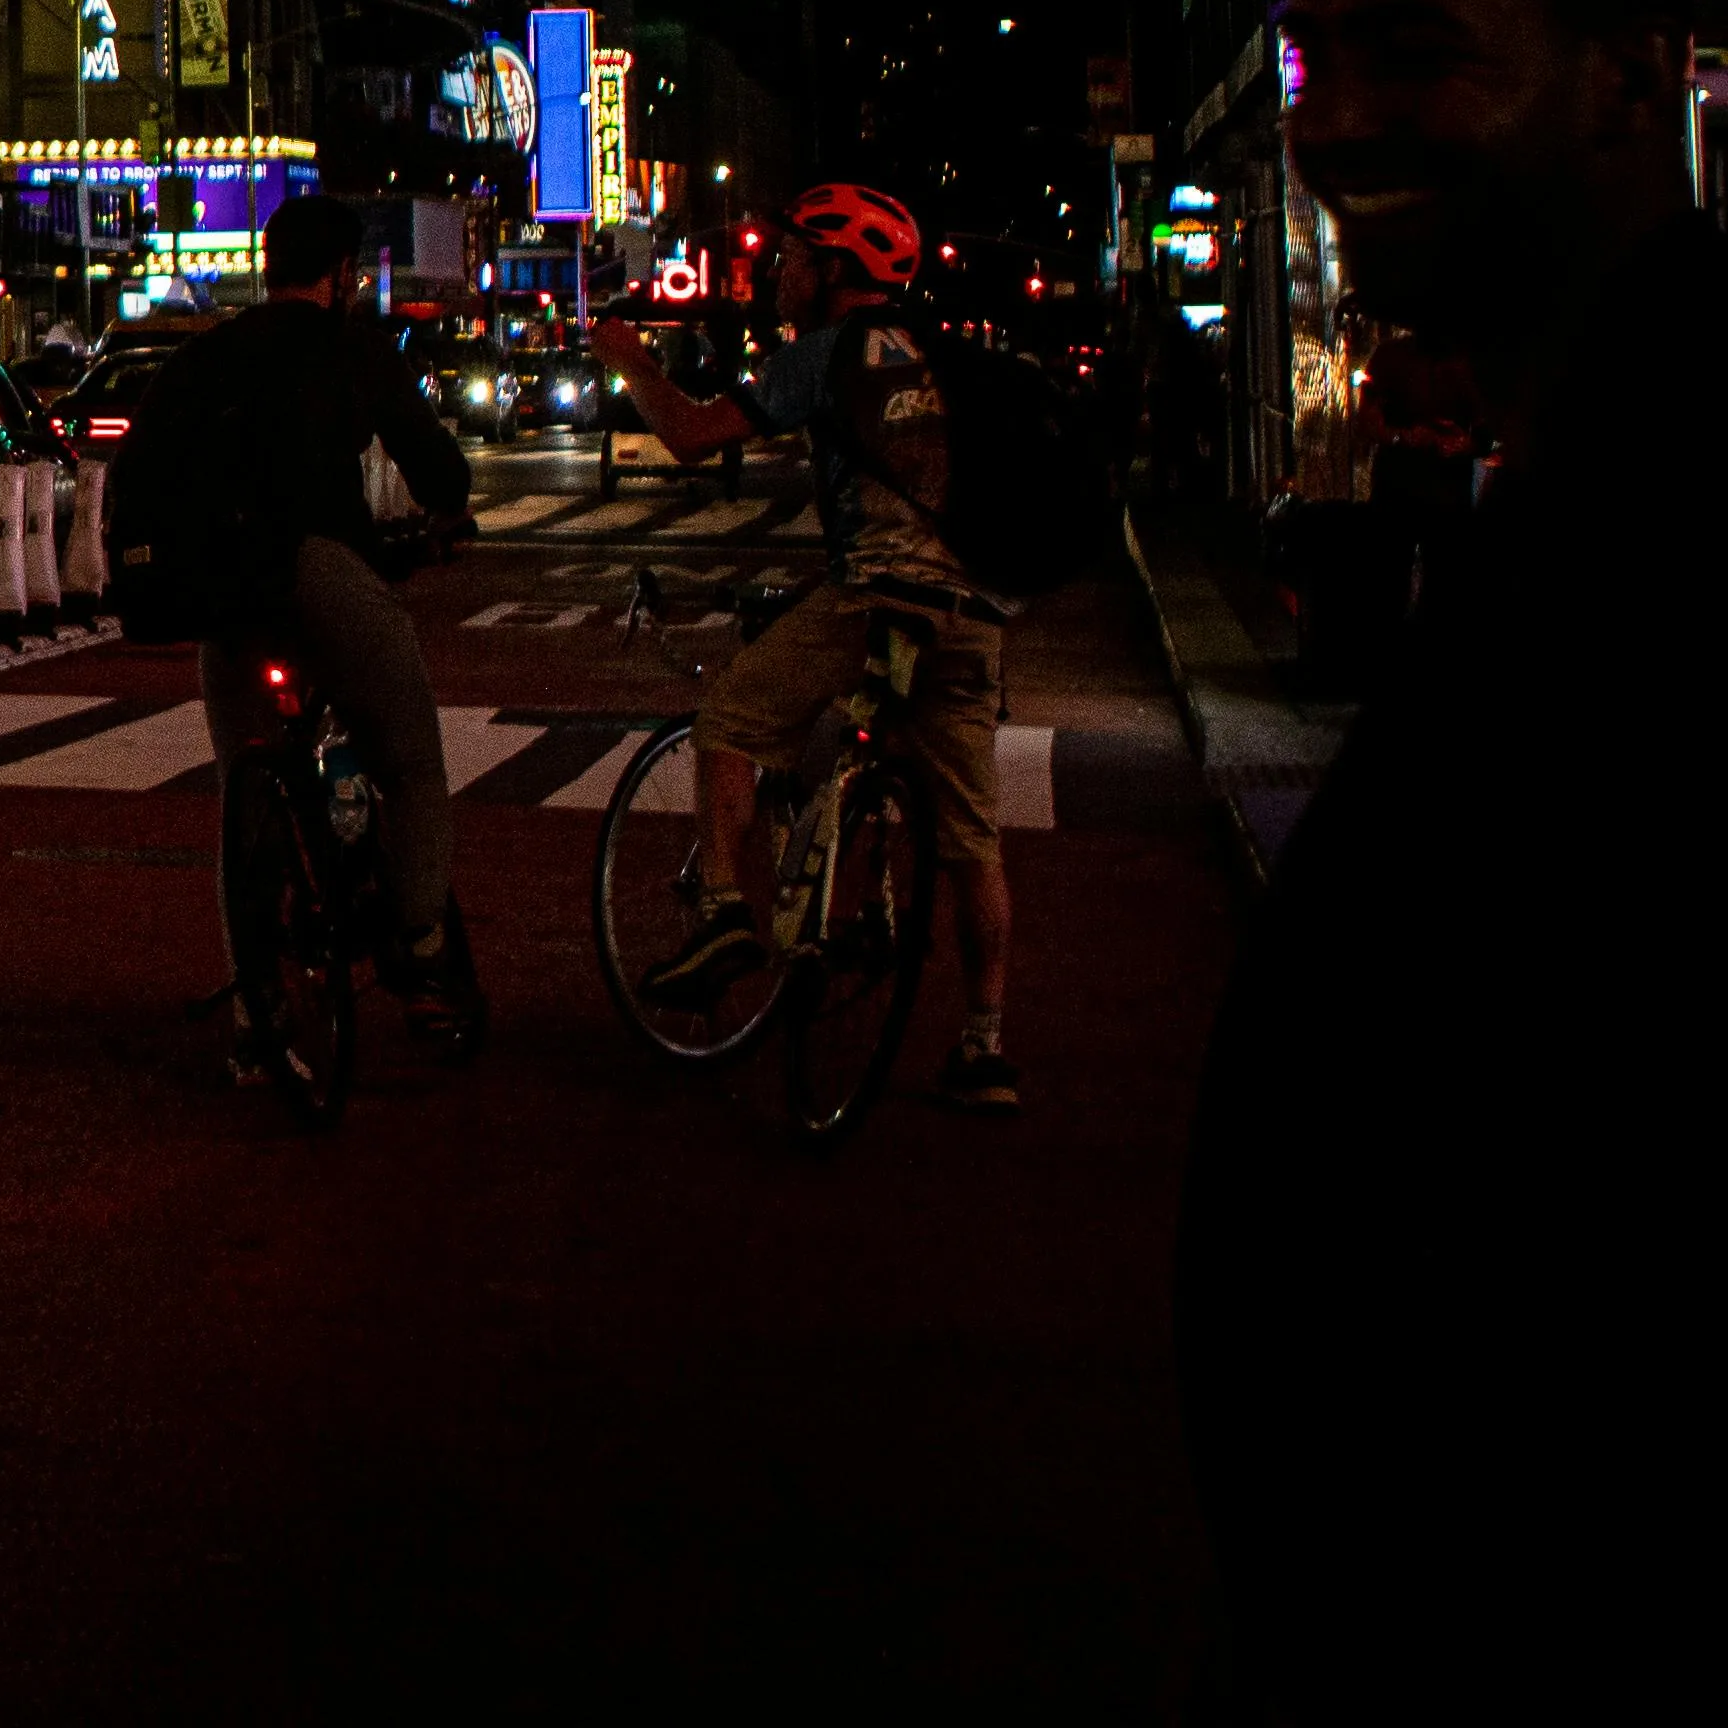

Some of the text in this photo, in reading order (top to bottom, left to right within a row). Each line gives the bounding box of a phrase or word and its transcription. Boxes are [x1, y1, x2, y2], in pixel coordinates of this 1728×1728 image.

[35, 167, 97, 181] RETURS
[103, 166, 120, 181] TO
[208, 164, 243, 179] SEPT
[601, 80, 619, 225] EMPIRE
